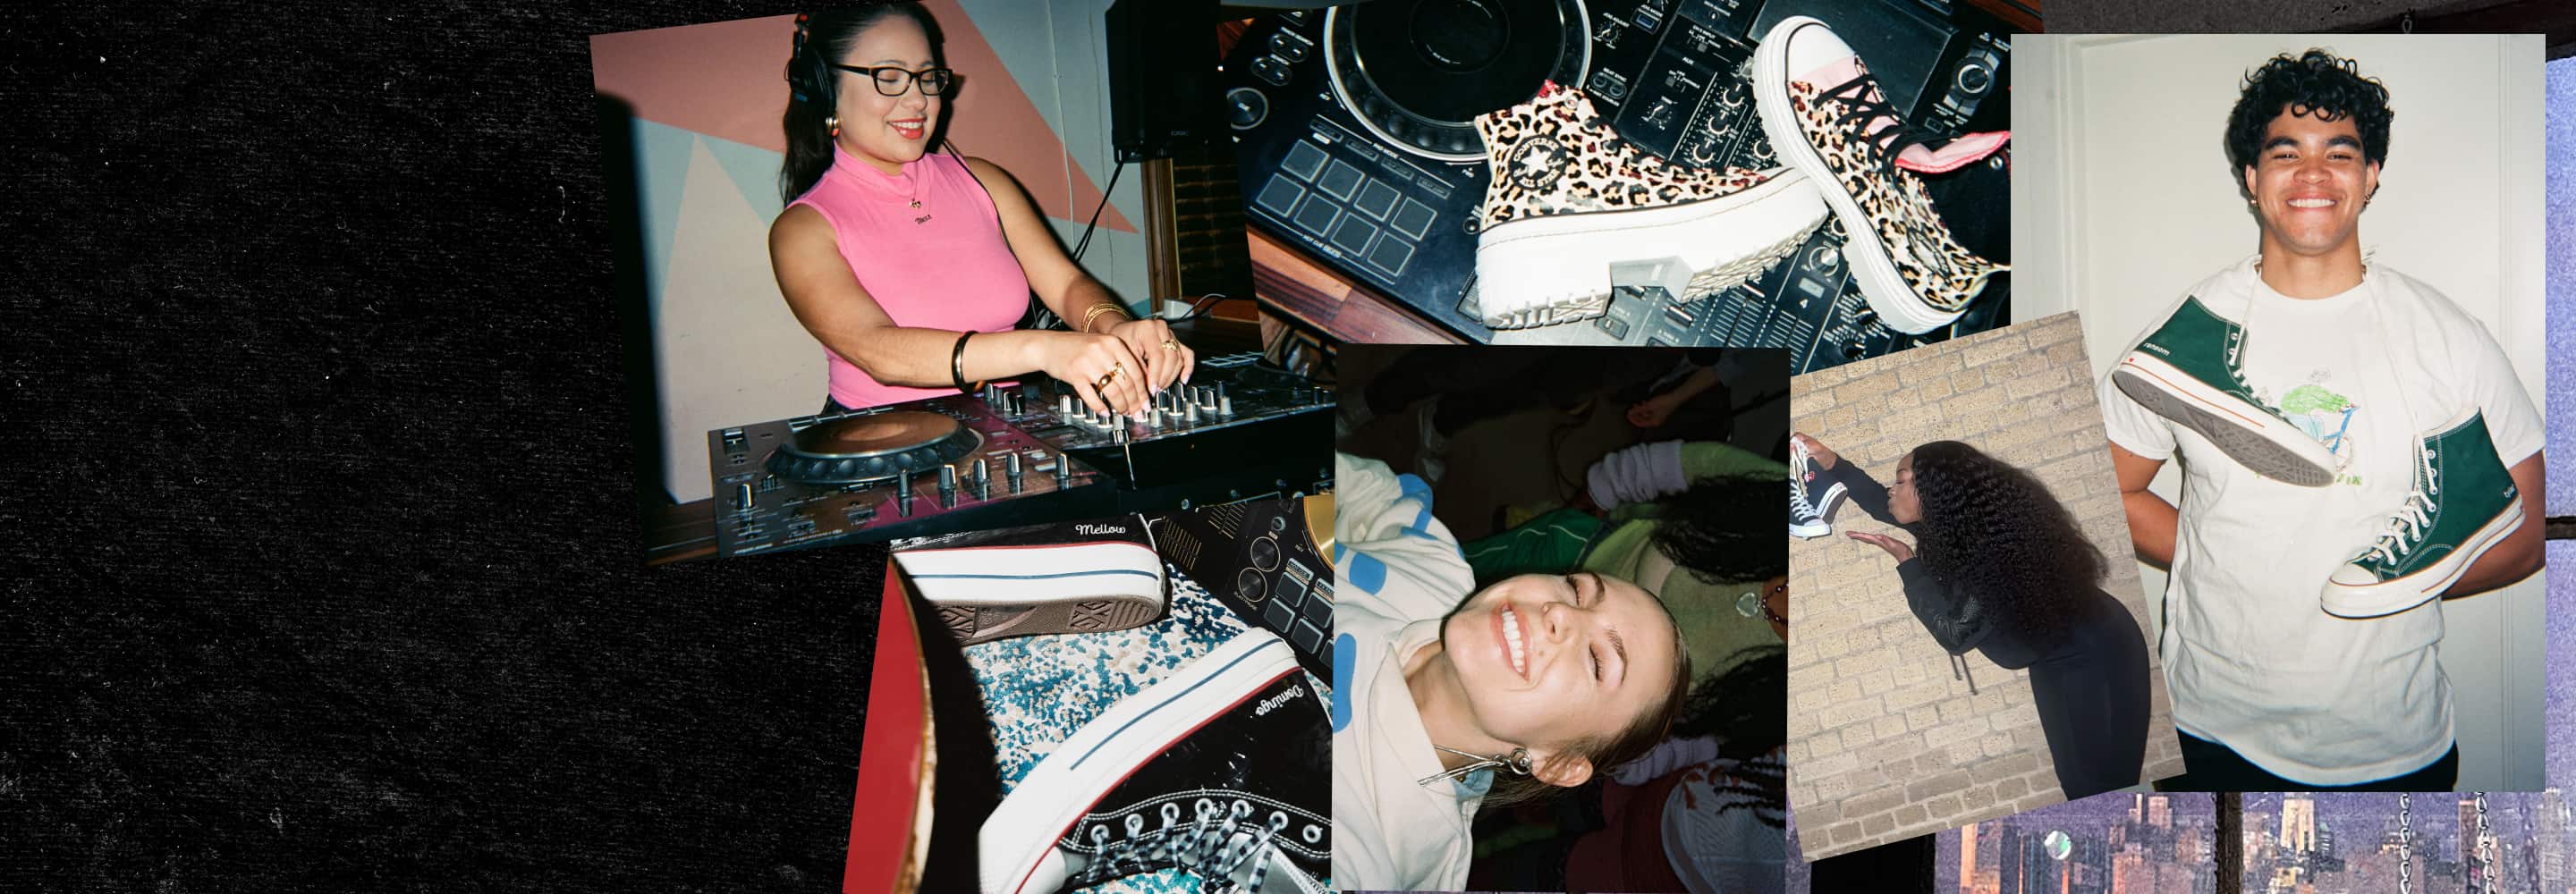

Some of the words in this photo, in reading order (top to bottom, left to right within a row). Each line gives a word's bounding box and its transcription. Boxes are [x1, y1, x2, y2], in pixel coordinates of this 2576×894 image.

[1513, 137, 1560, 162] CONVERSE
[1537, 169, 1561, 187] STAR
[2143, 342, 2171, 357] ransom
[1075, 523, 1126, 536] Mellow
[1255, 684, 1304, 716] Domingo
